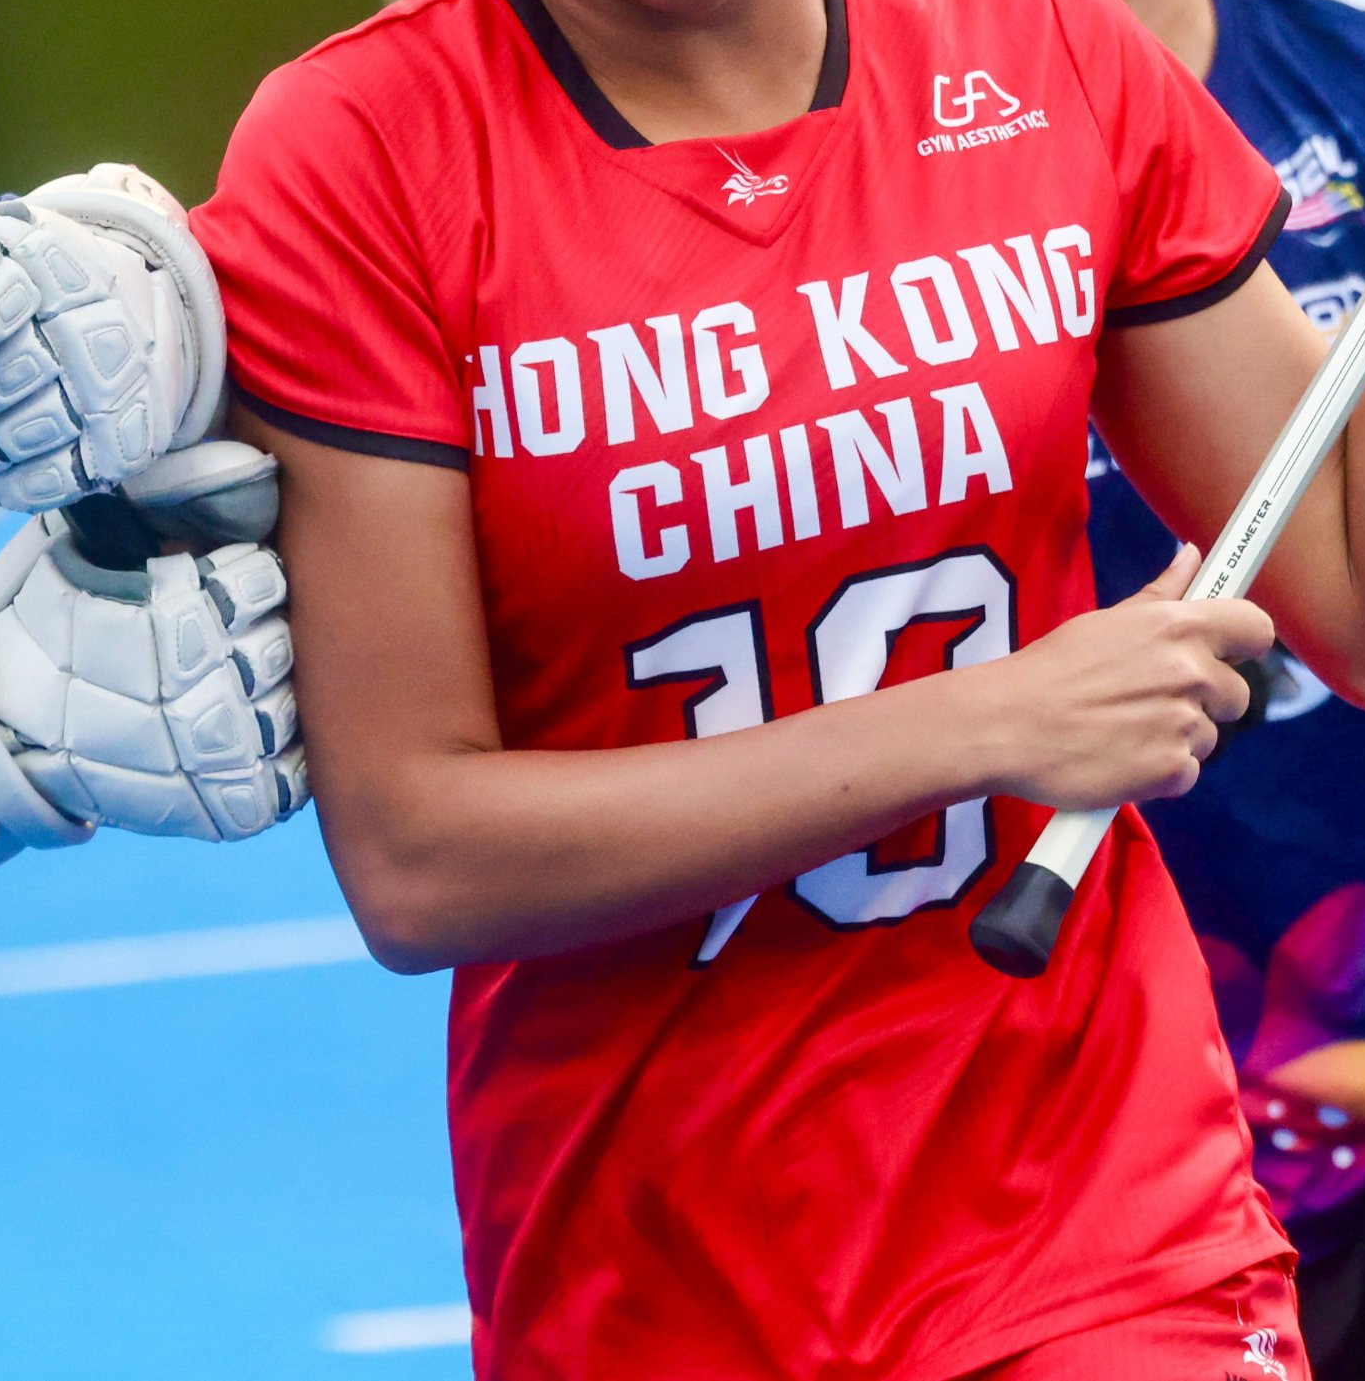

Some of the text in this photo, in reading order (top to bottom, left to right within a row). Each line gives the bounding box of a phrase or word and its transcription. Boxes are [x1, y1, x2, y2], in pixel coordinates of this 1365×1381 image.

[916, 134, 956, 157] GYM
[465, 224, 1096, 459] HONG KONG
[609, 381, 1013, 581] CHINA
[1226, 499, 1273, 569] DIAMETER
